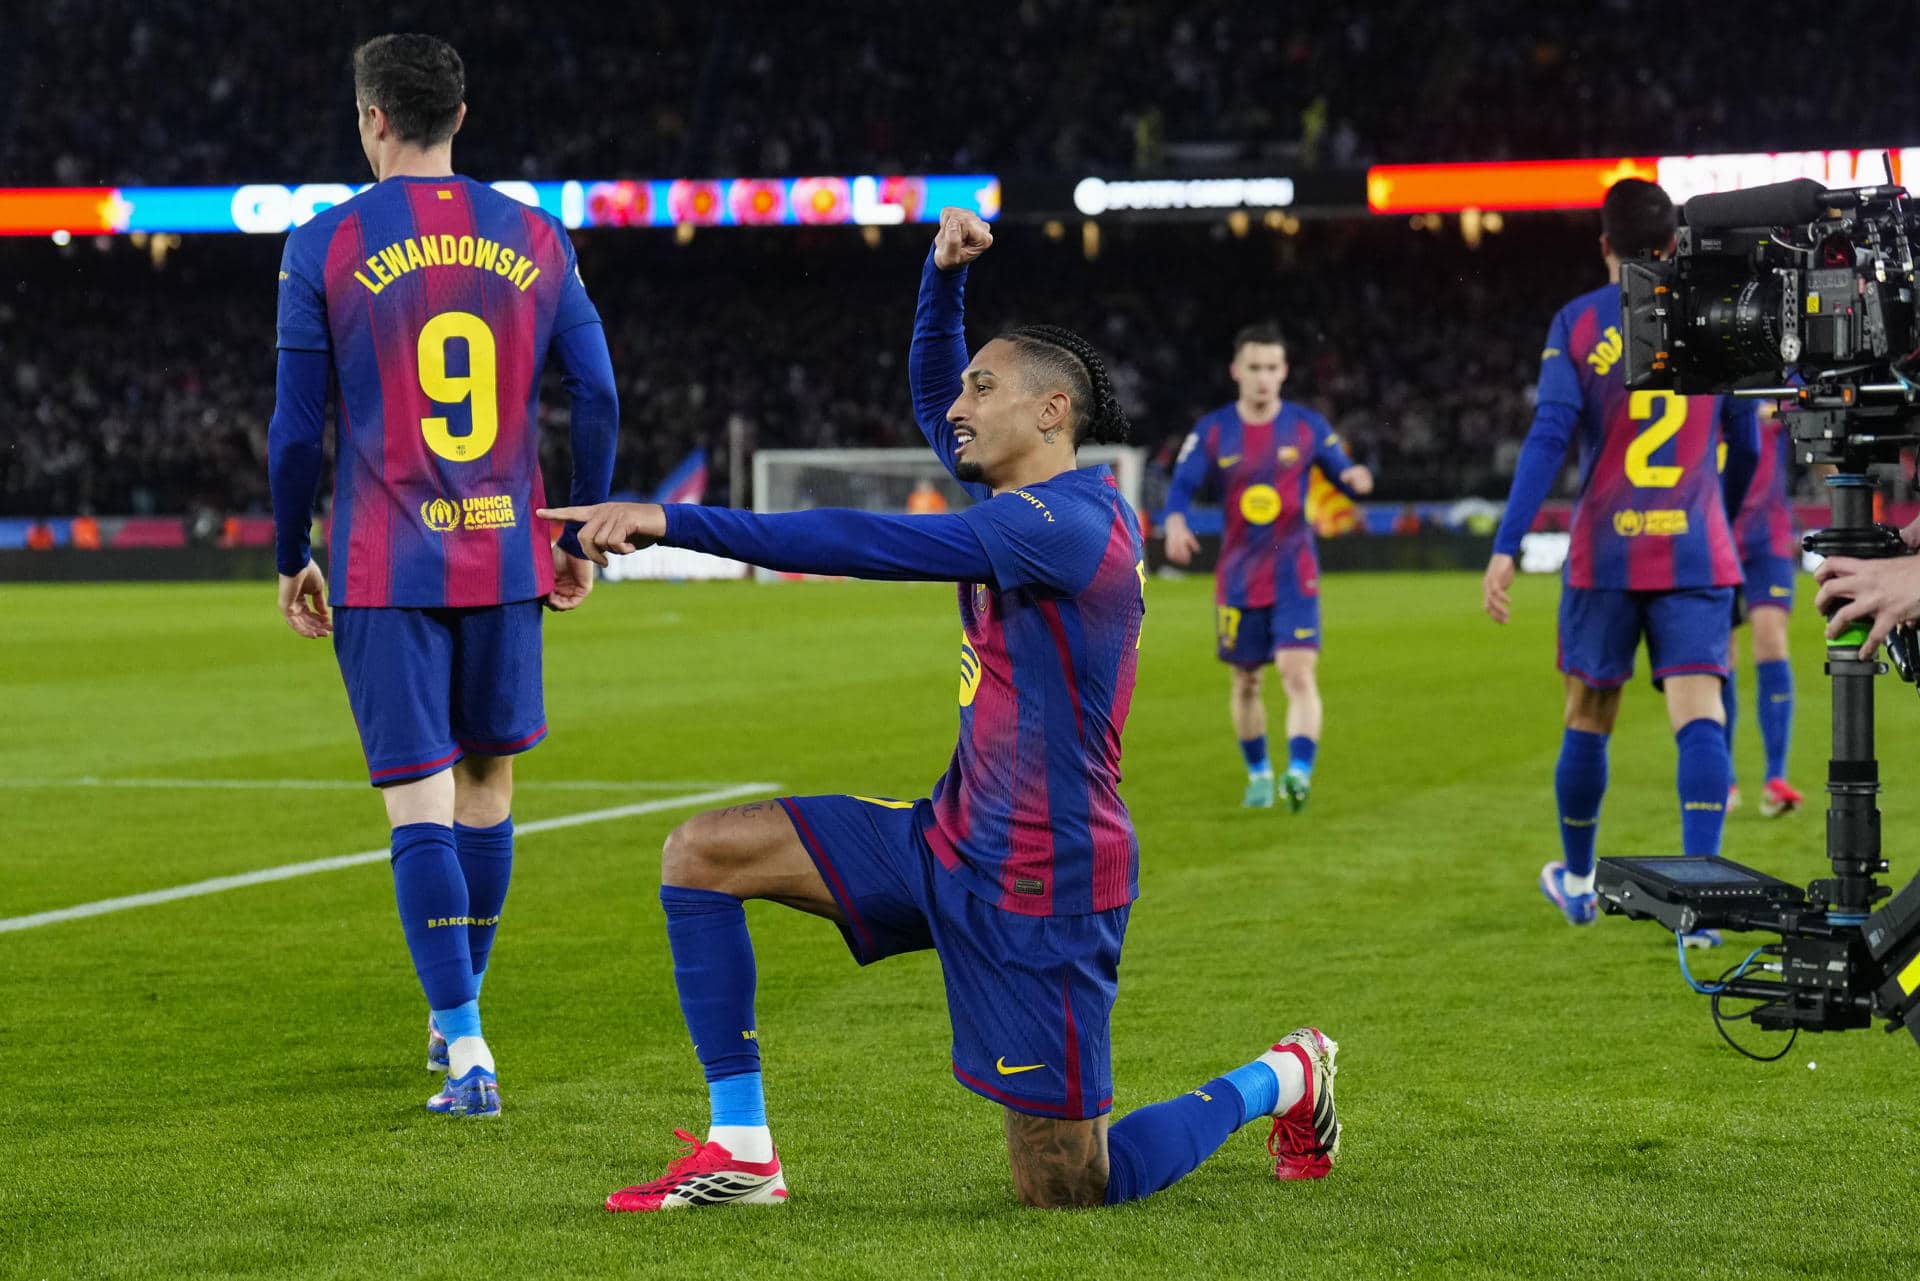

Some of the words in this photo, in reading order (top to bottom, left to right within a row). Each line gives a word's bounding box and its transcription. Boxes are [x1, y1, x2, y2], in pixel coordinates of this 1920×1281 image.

[353, 234, 541, 295] LEWANDOWSKI
[417, 311, 498, 463] 9
[1624, 390, 1688, 488] 2
[462, 495, 512, 512] UNHCR
[463, 508, 515, 525] ACNUR
